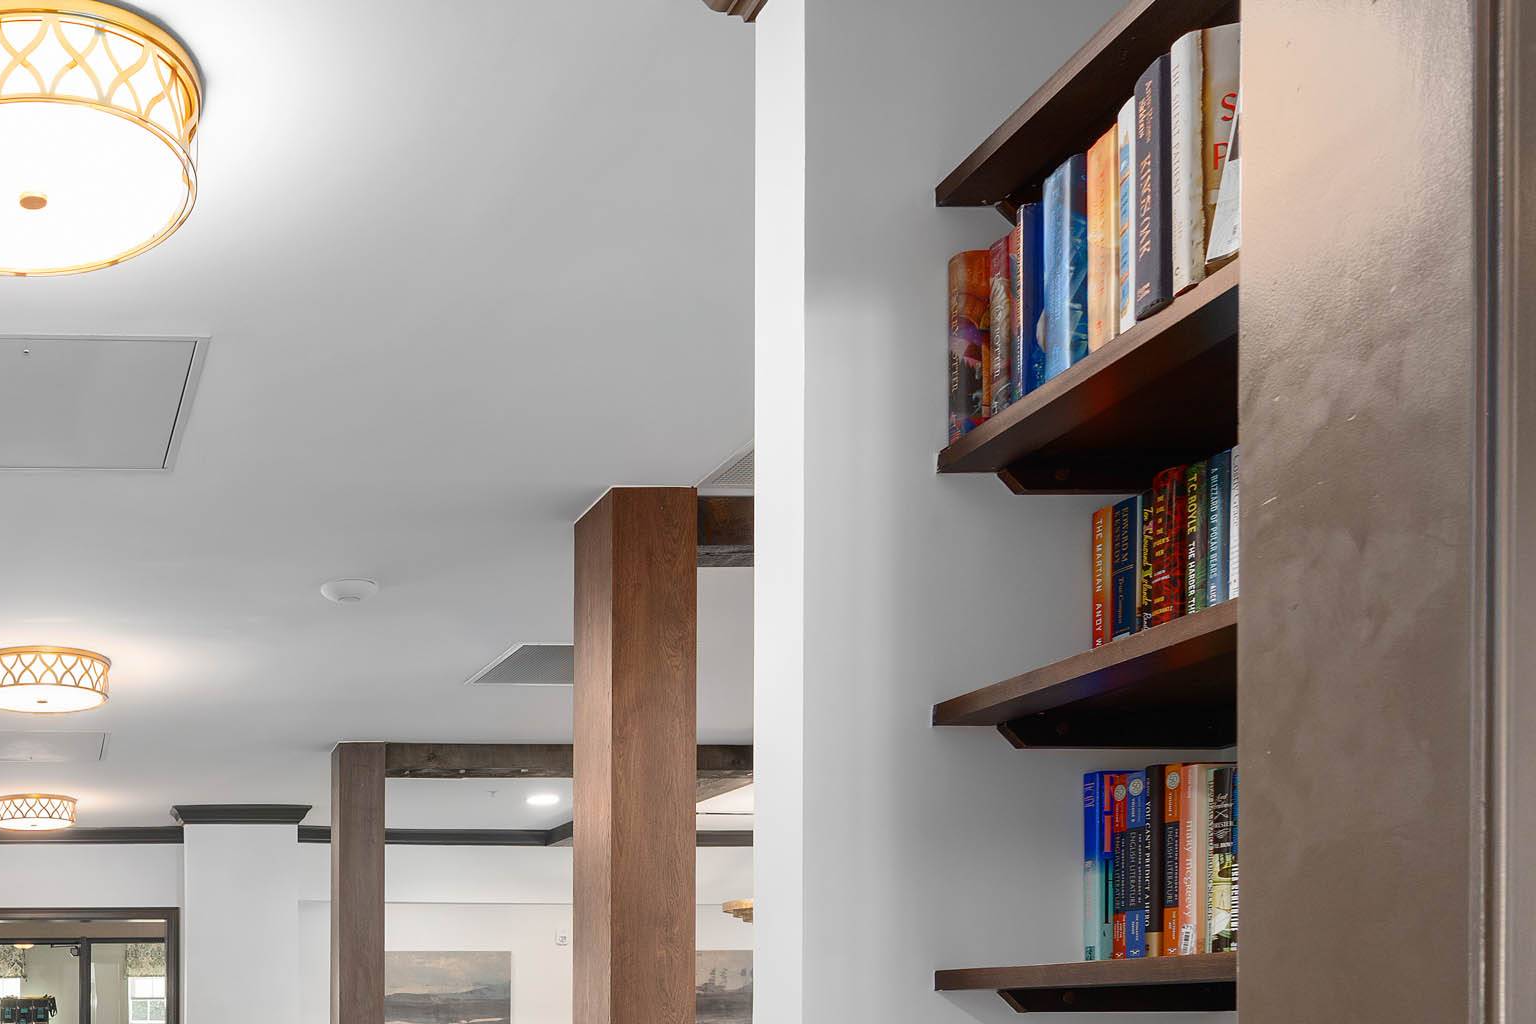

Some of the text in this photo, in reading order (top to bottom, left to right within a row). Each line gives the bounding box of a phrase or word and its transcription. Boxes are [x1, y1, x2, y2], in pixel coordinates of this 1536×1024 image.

[1210, 475, 1218, 512] BLIZZARD
[1095, 518, 1103, 541] THE
[1187, 495, 1198, 535] BOYLE
[1187, 541, 1196, 560] THE
[1210, 527, 1218, 551] POLAR
[1095, 544, 1103, 593] MARTIAN
[1187, 562, 1196, 596] HARDER
[1210, 553, 1218, 579] BEARS
[1095, 603, 1103, 631] ANDY
[1129, 832, 1137, 906] ENGLISH LITERATURE
[1166, 826, 1174, 903] ENGLISH LITERATURE
